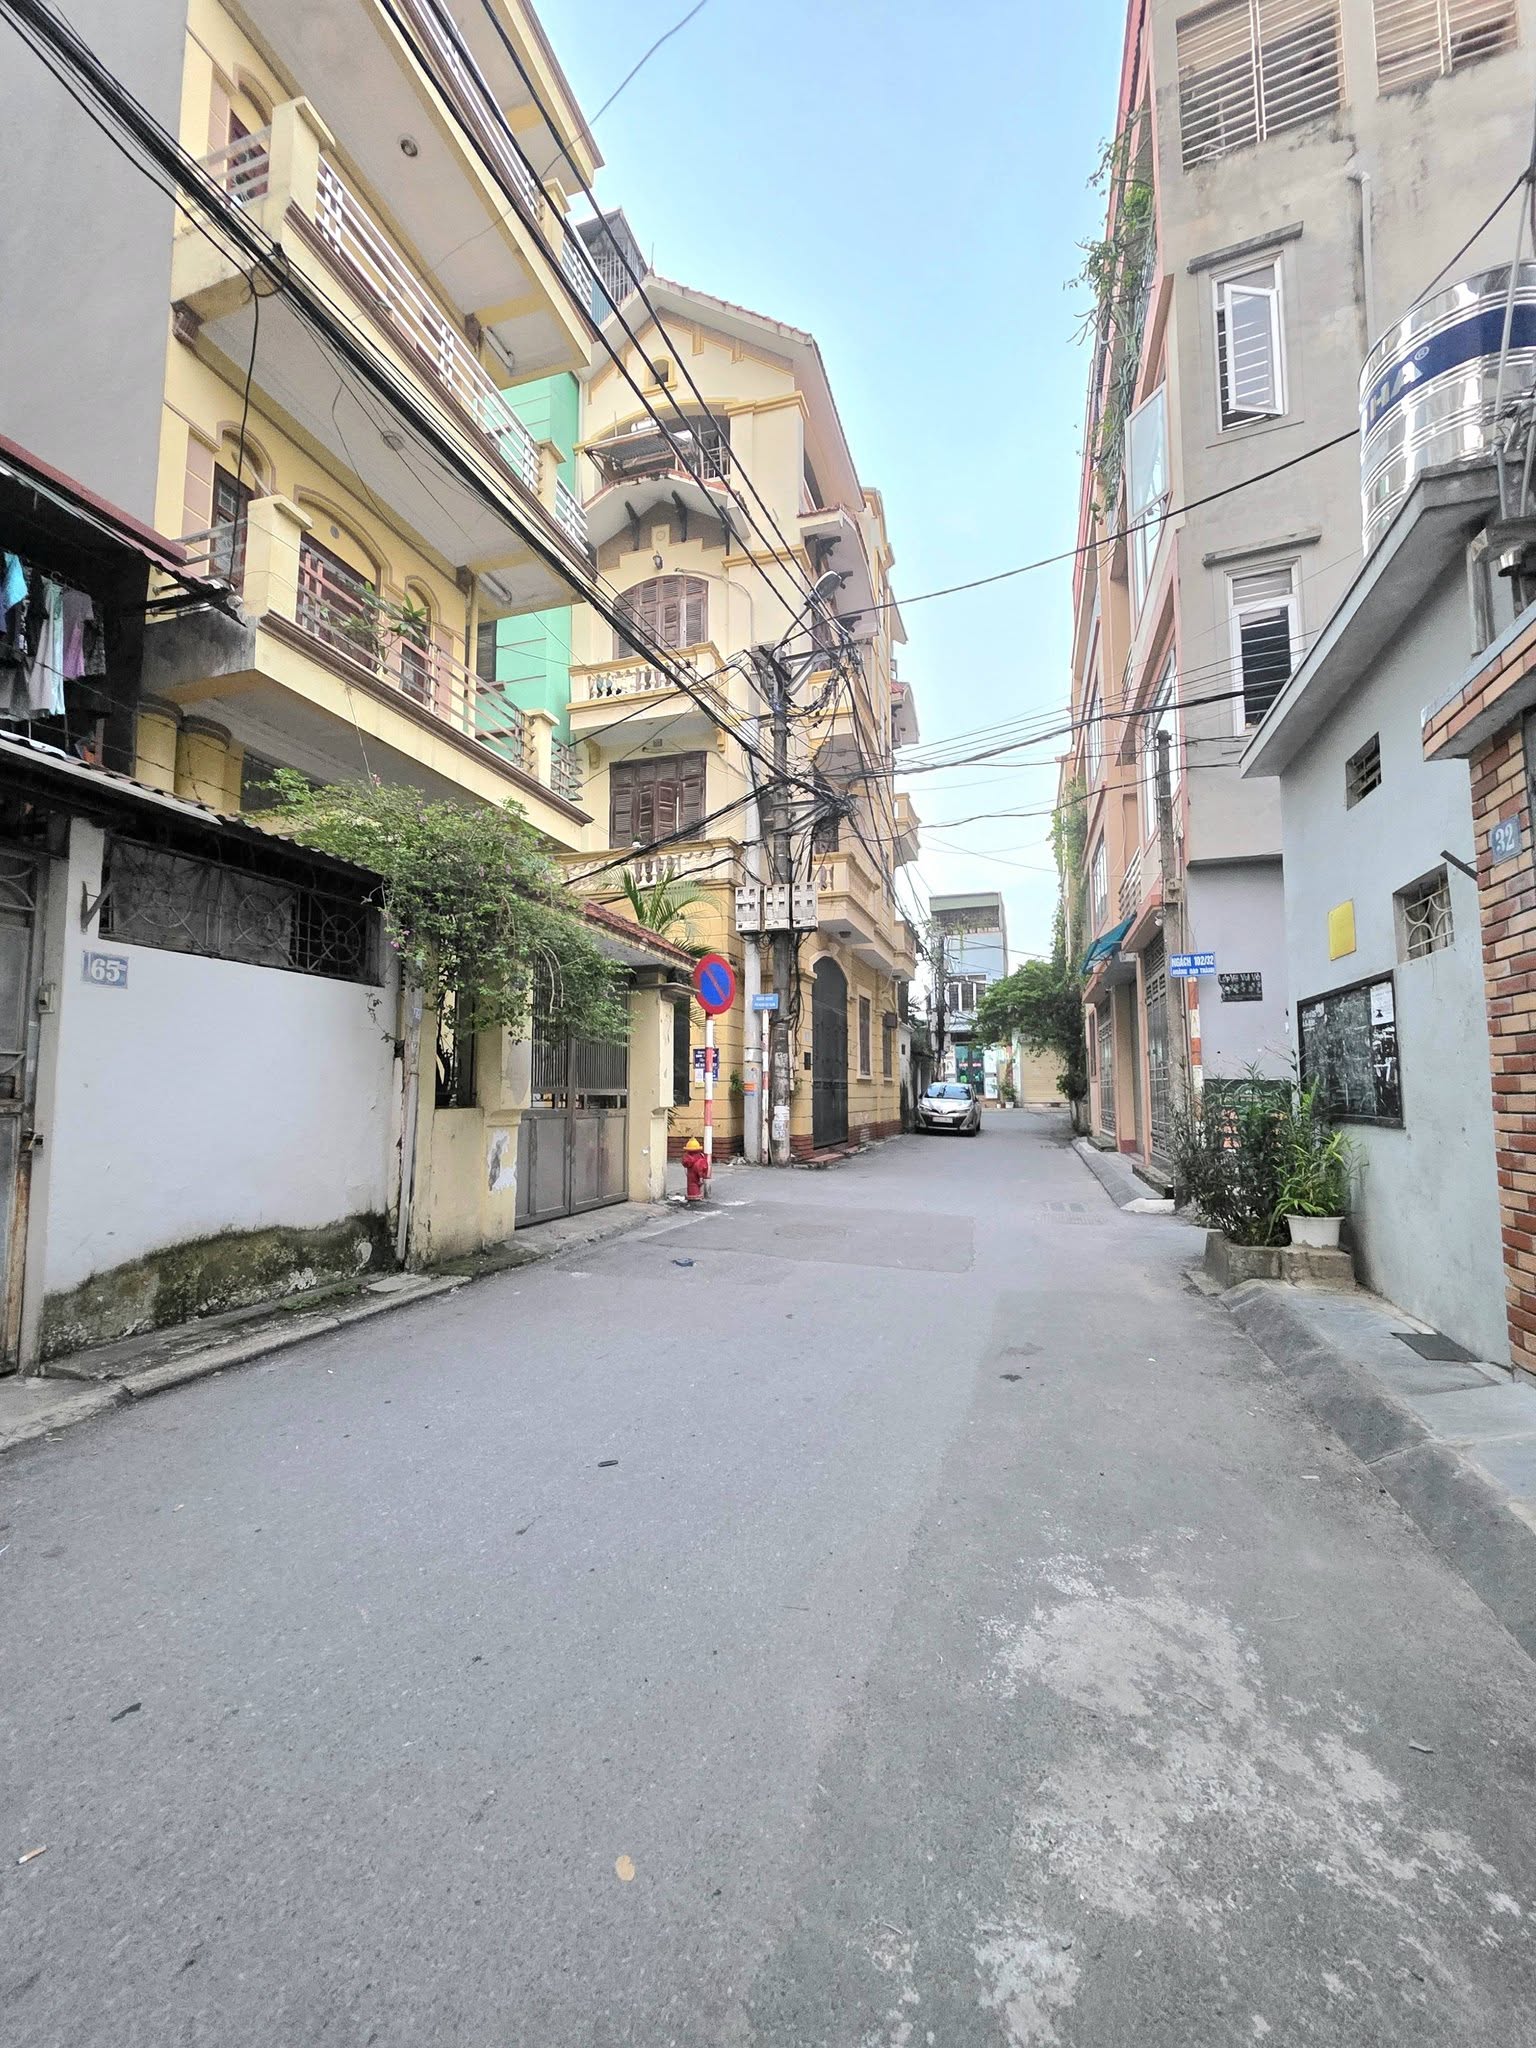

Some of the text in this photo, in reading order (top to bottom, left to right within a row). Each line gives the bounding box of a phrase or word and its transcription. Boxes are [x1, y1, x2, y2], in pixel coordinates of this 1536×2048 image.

[1495, 823, 1515, 852] 32
[91, 958, 120, 982] 65
[1172, 955, 1214, 967] NGÁCH 102/32
